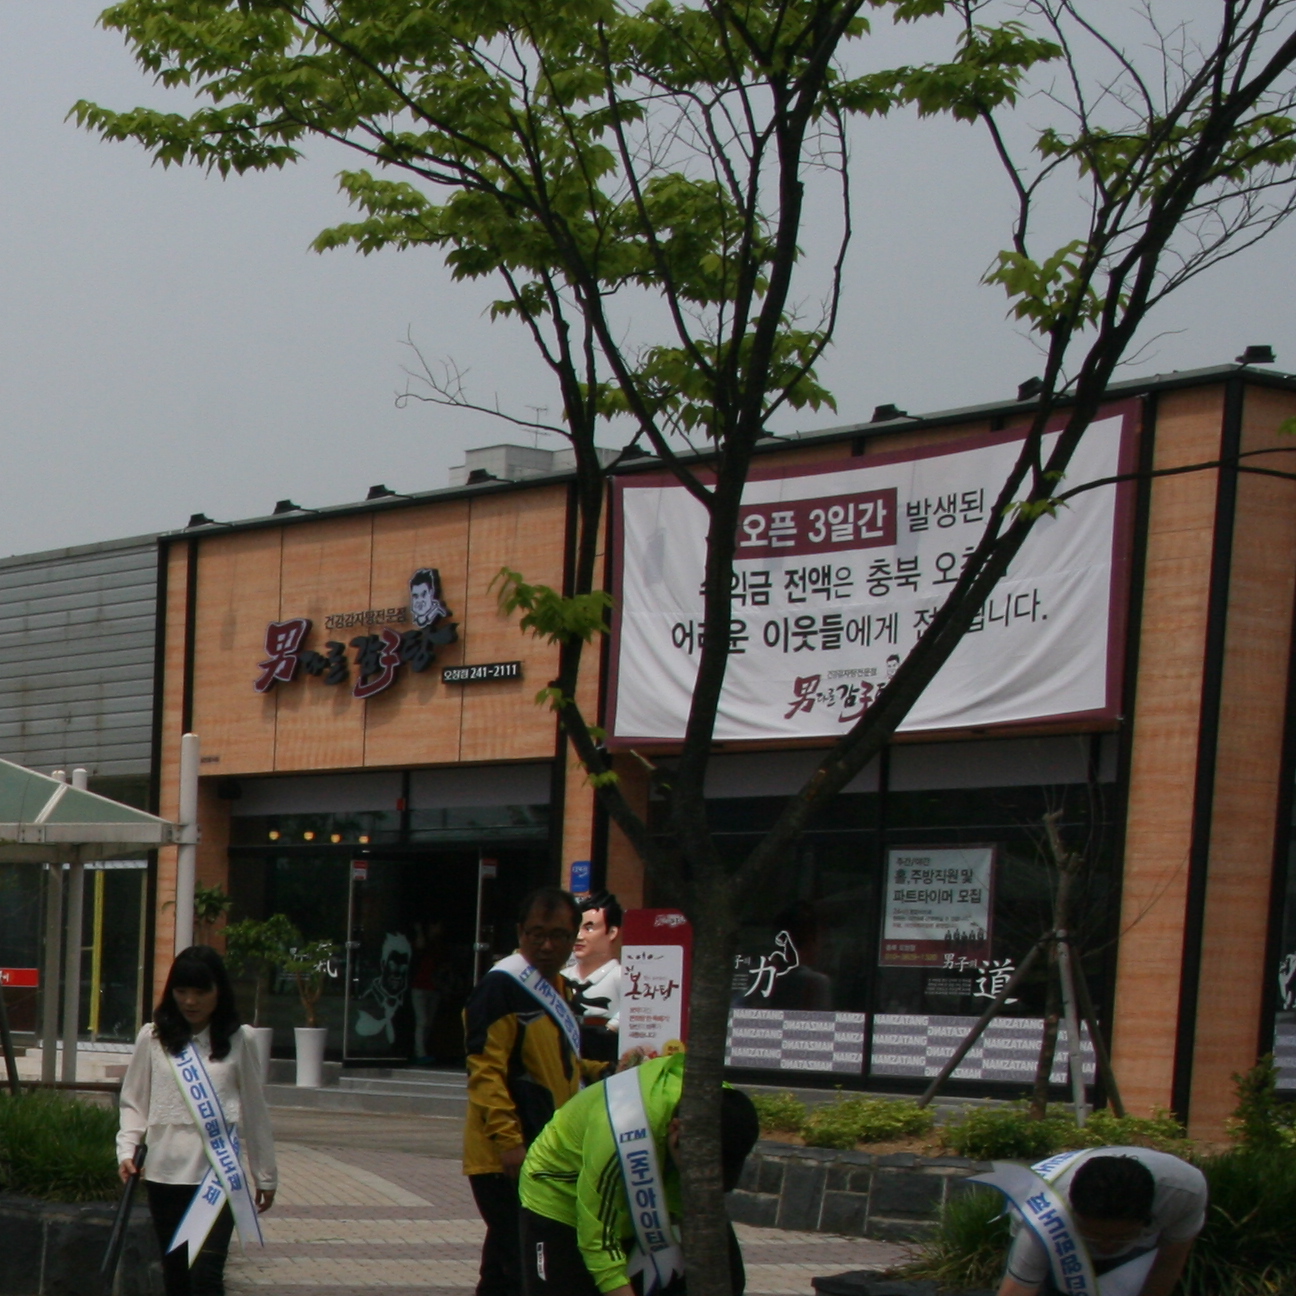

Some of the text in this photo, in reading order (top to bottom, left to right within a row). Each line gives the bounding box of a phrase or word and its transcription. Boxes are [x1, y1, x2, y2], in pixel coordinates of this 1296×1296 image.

[740, 488, 986, 549] 오픈 3일간 발생된
[699, 570, 774, 608] 익금
[784, 563, 855, 604] 전액은
[866, 558, 922, 596] 충북
[763, 611, 900, 653] 이웃들에게
[470, 664, 518, 679] 241-2111
[961, 869, 974, 885] 및
[893, 888, 983, 904] 파트타이머 모집
[618, 1127, 647, 1144] ITM
